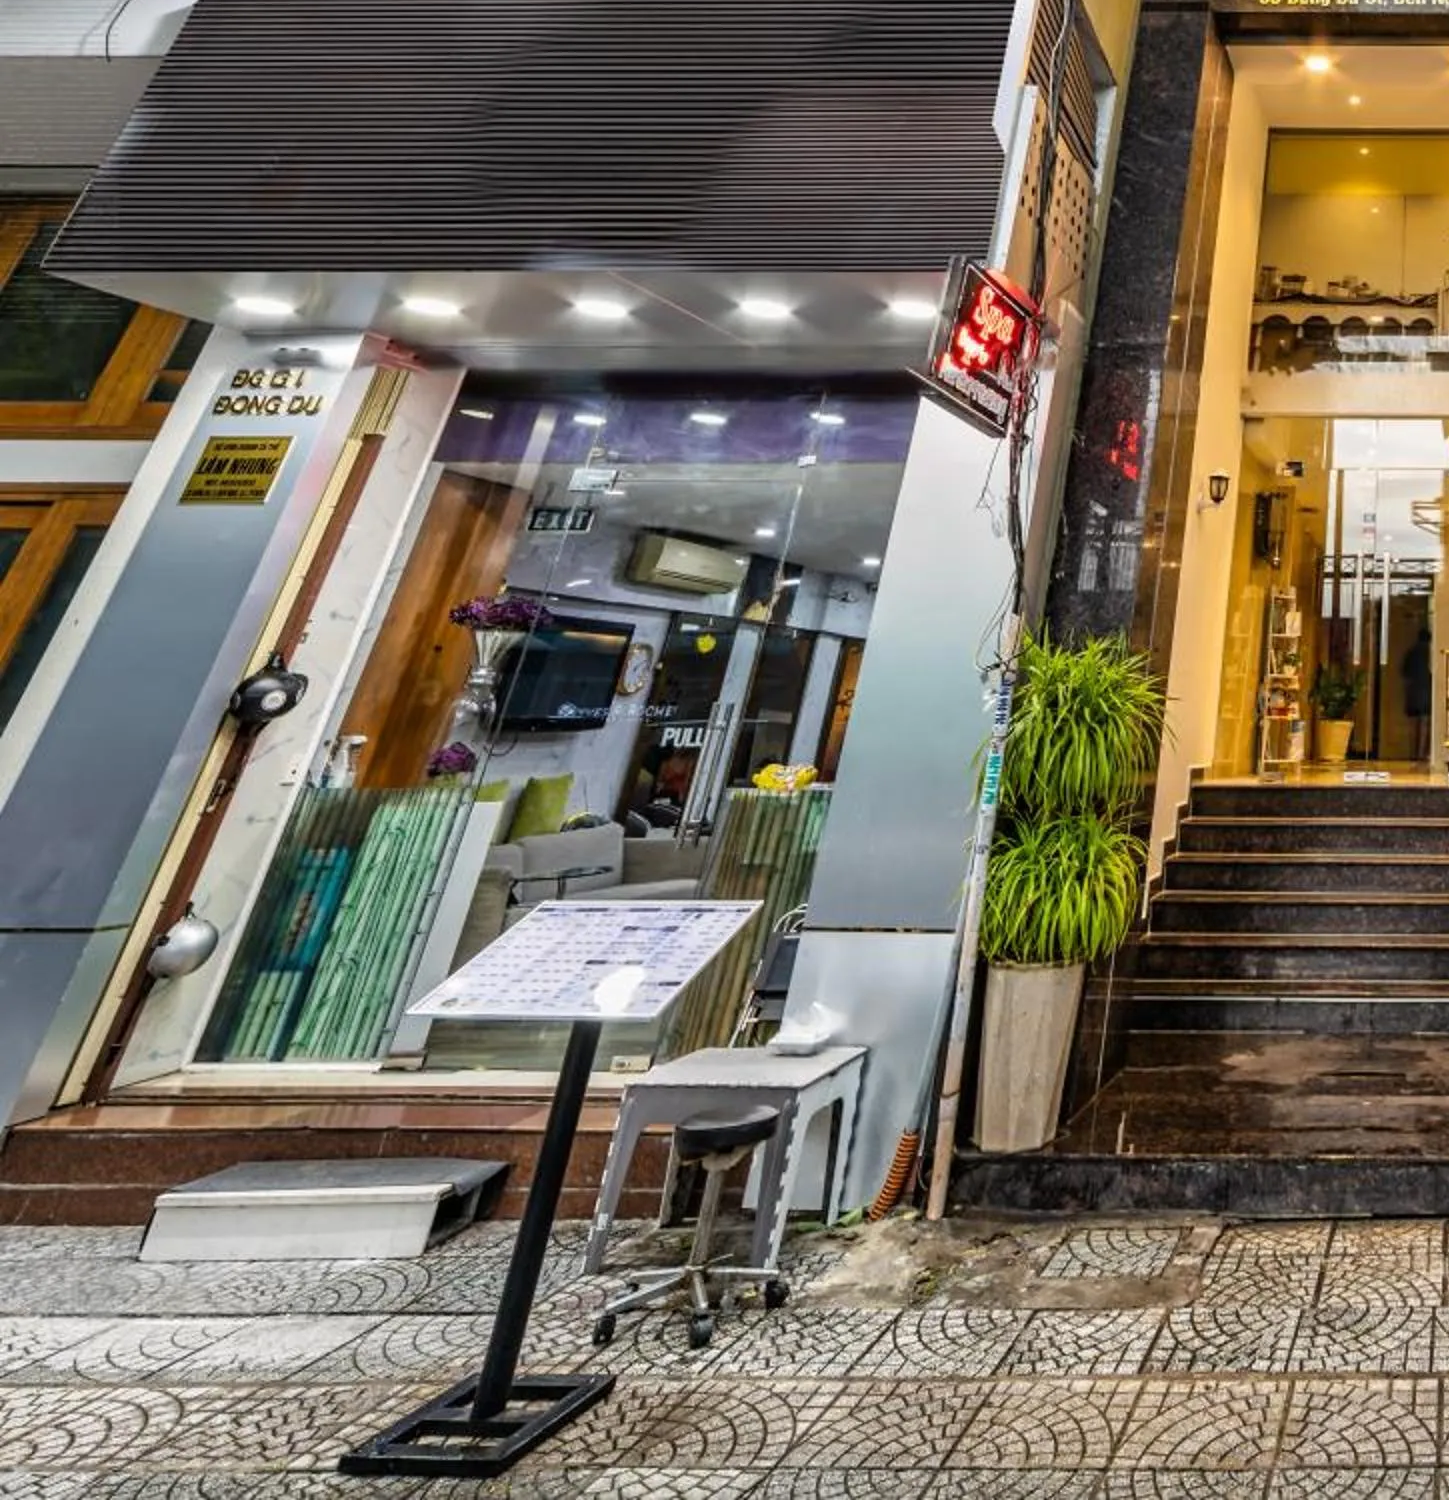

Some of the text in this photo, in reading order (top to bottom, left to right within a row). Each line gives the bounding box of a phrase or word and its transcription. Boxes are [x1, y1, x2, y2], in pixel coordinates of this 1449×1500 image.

[287, 395, 323, 416] DU
[533, 510, 590, 529] EXIT
[660, 727, 705, 747] PULL
